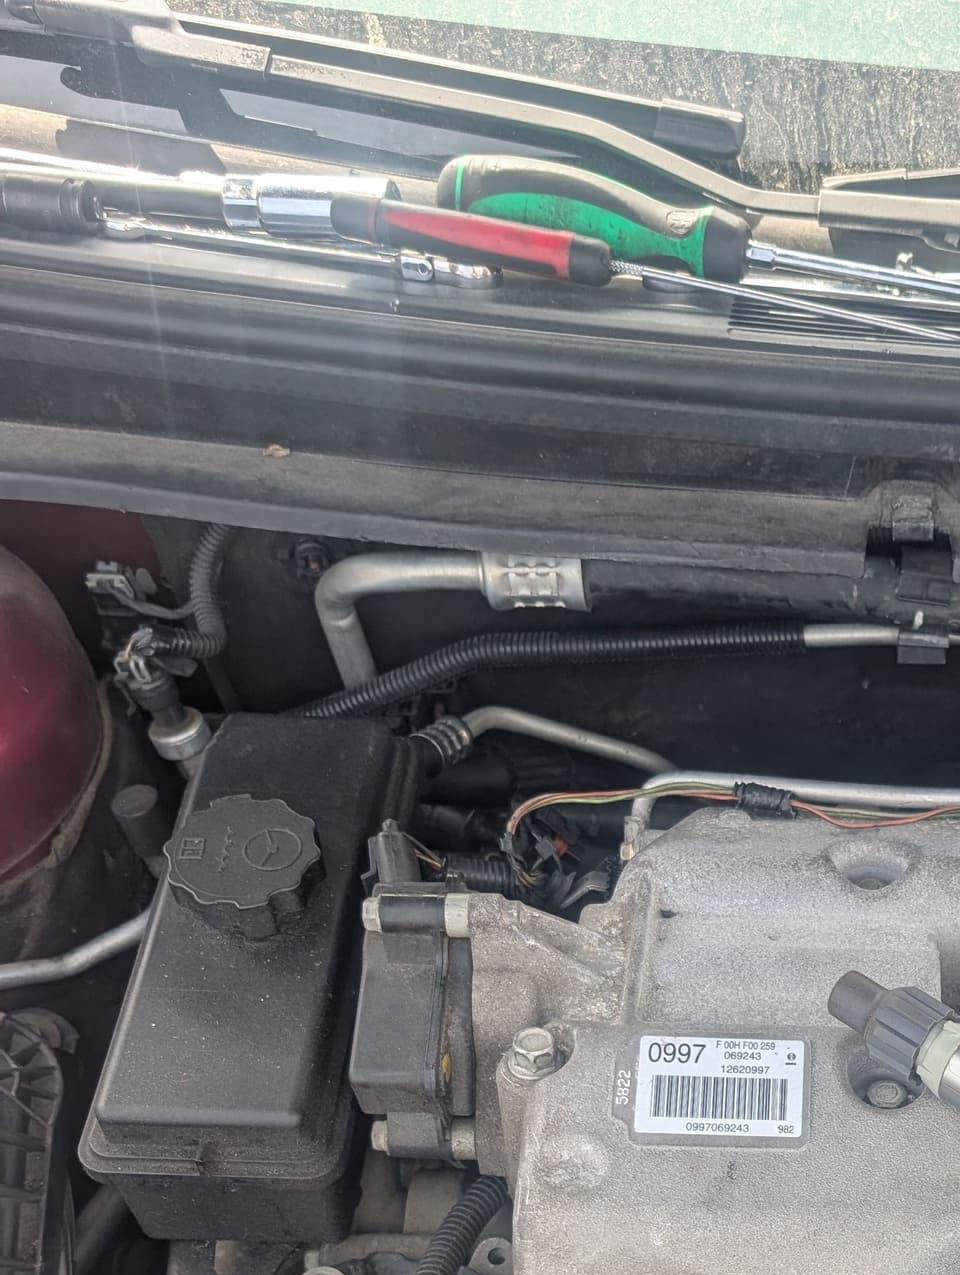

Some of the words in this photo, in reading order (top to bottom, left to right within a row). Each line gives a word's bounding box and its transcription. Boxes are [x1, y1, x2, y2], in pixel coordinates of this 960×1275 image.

[716, 1040, 722, 1048] F
[724, 1040, 741, 1049] 00H
[743, 1041, 759, 1050] F00
[760, 1041, 776, 1051] 259
[648, 1042, 706, 1064] 0997
[724, 1051, 762, 1061] 069243
[721, 1065, 770, 1075] 12620997
[615, 1069, 632, 1105] 5822
[685, 1122, 750, 1132] 0997069243
[777, 1125, 794, 1134] 982
